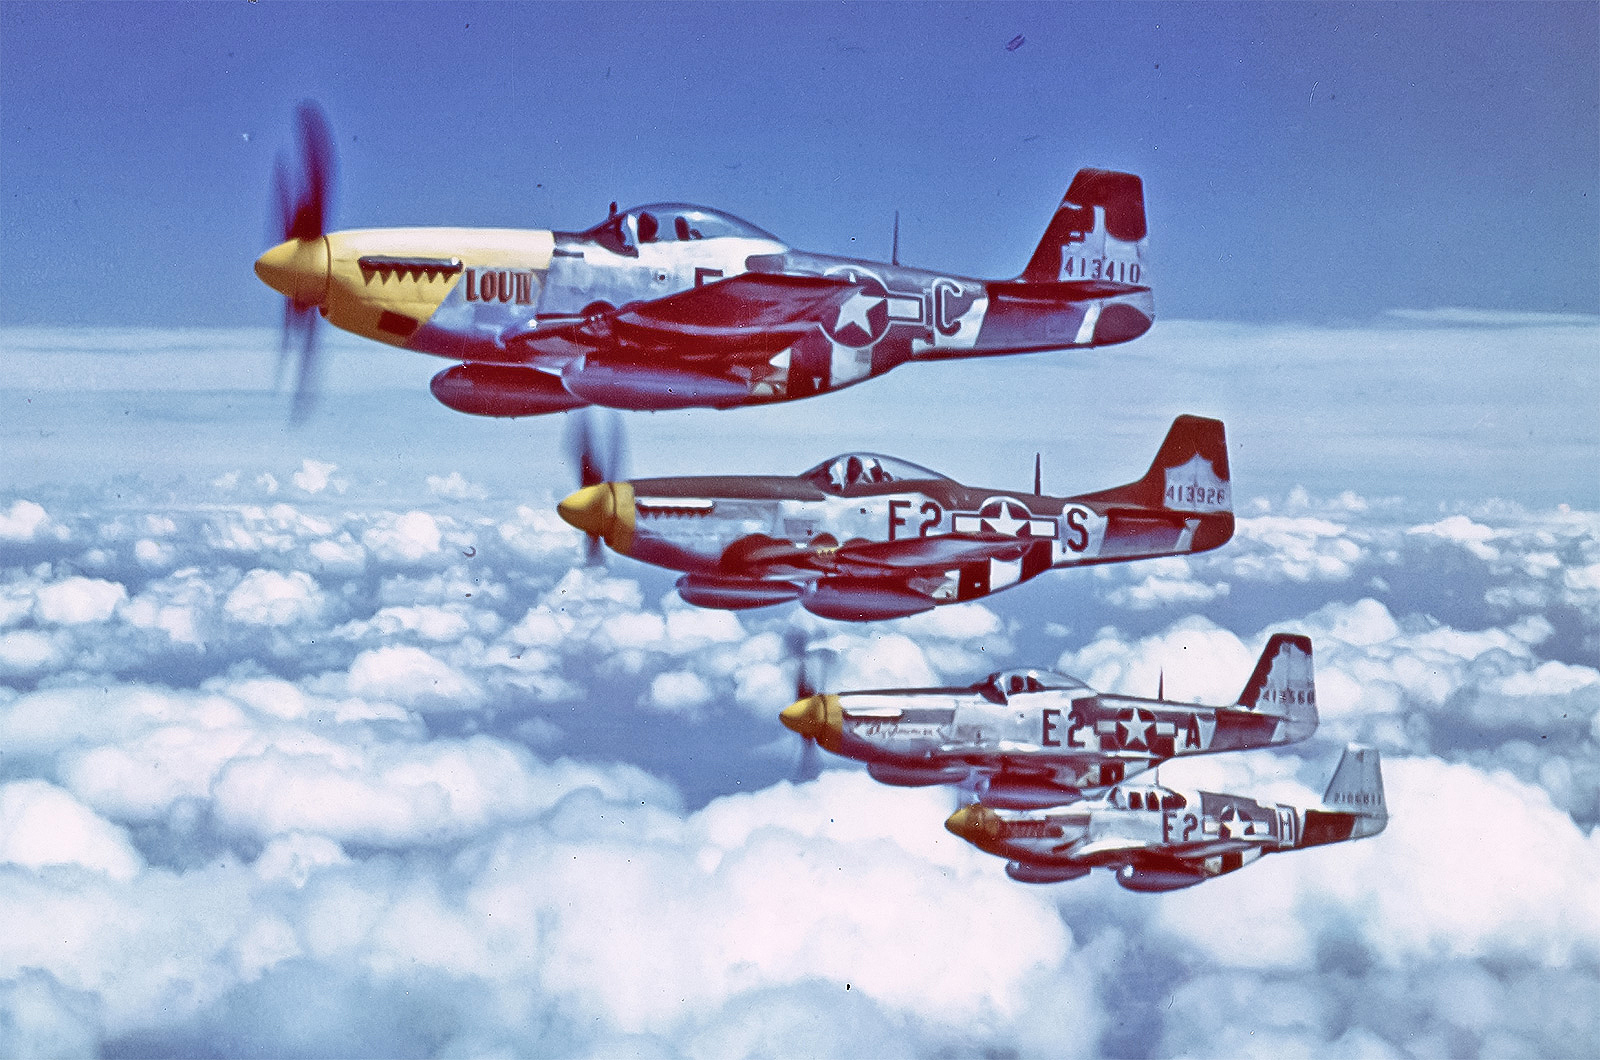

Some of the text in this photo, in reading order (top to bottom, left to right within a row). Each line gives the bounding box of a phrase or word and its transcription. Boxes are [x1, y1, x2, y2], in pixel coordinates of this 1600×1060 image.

[1064, 257, 1140, 283] 413410
[932, 278, 962, 337] C
[1067, 508, 1089, 552] S
[1043, 709, 1201, 749] E2 A
[1278, 810, 1294, 842] H
